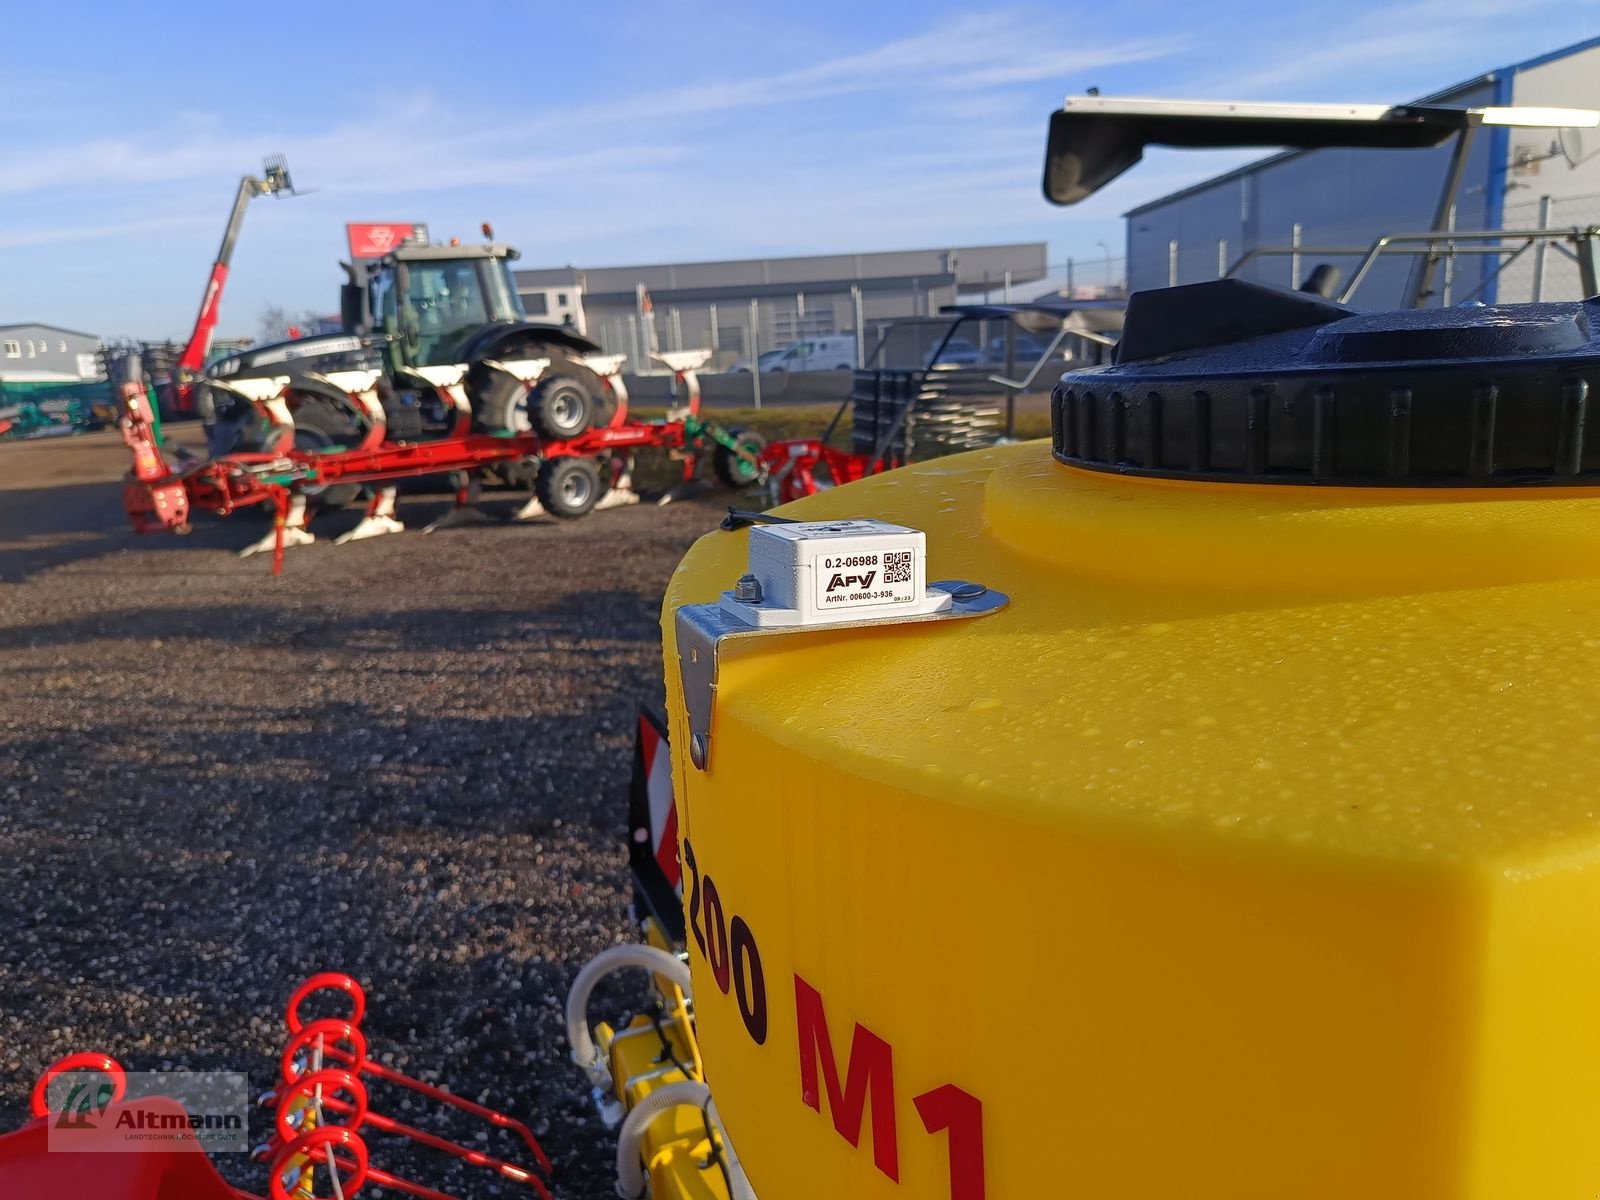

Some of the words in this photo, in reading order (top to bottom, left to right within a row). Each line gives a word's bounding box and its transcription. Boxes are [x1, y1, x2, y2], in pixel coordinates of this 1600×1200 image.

[825, 555, 878, 569] 0.2-06988
[826, 570, 877, 592] APV
[825, 594, 848, 603] ArtNr.
[849, 590, 893, 601] 00600-3-936
[684, 837, 768, 1046] 200
[793, 971, 986, 1200] M1
